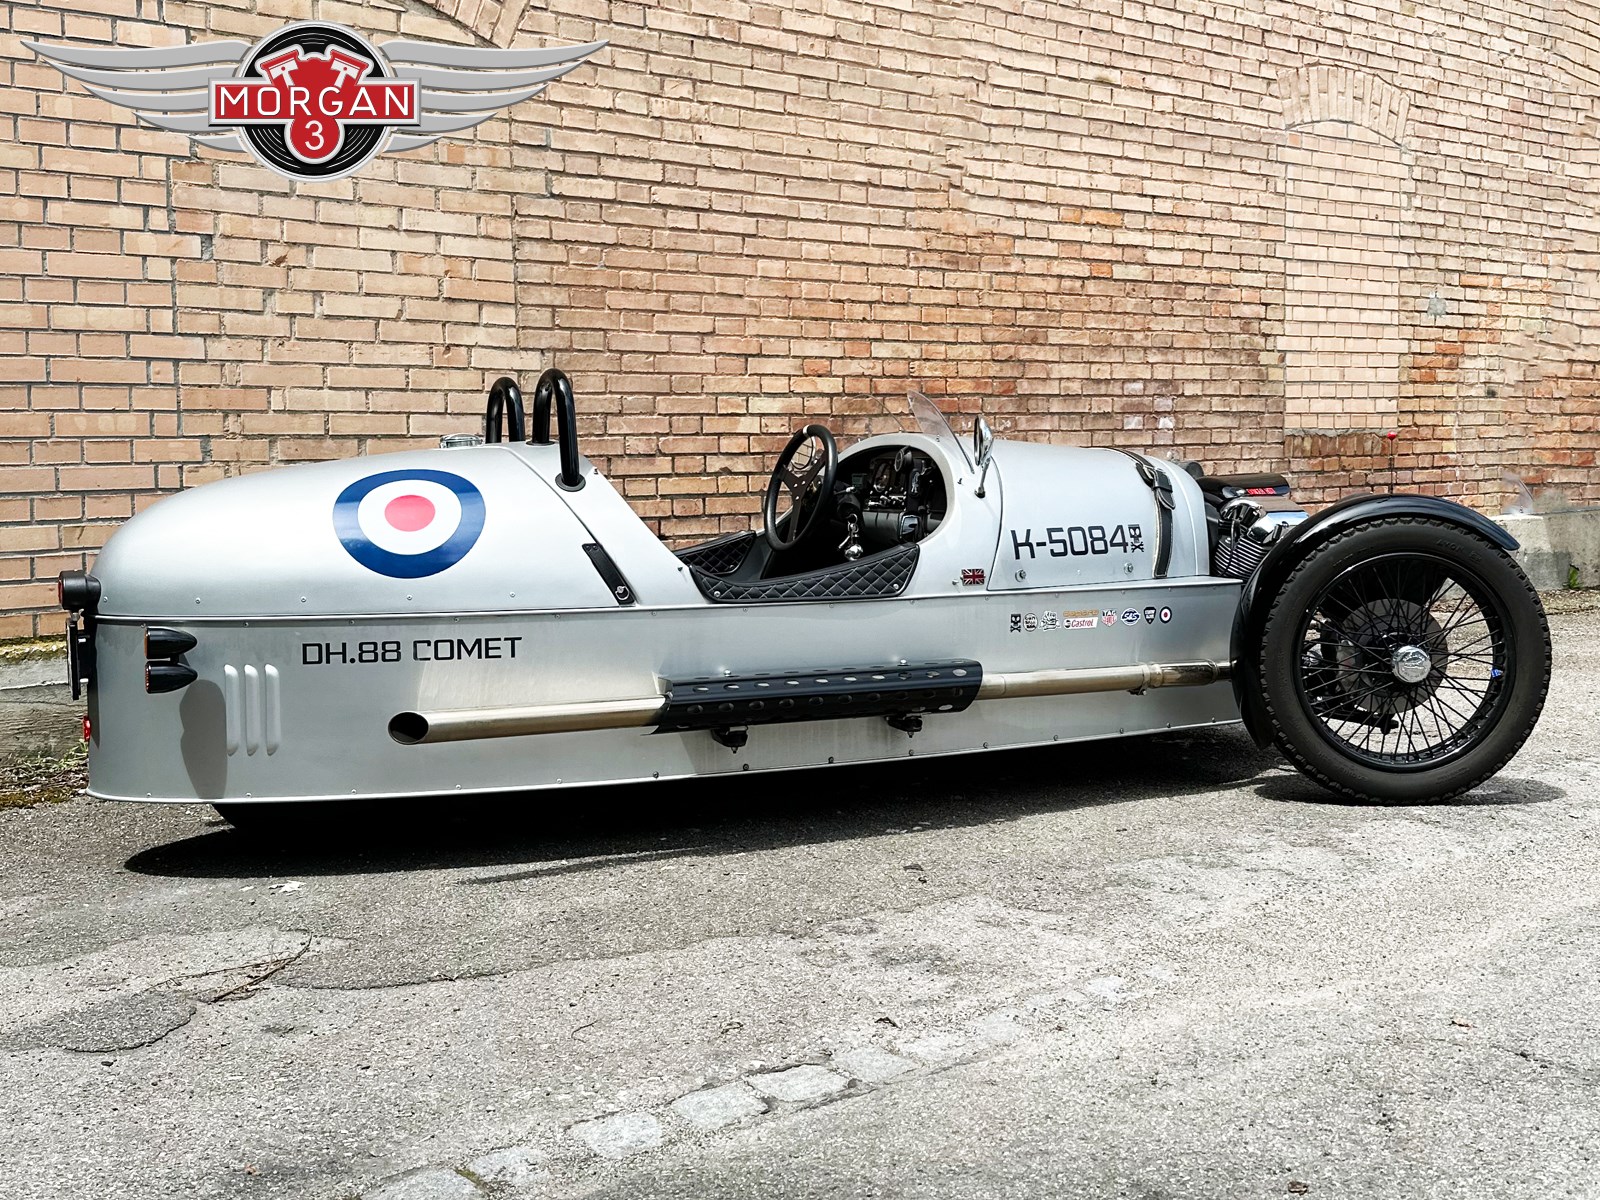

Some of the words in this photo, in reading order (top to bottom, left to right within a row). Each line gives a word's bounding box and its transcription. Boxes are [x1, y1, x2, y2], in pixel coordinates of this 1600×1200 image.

[1010, 524, 1129, 560] K-5084
[1071, 618, 1094, 628] Castrol
[302, 640, 402, 665] DH.88
[412, 636, 523, 662] COMET
